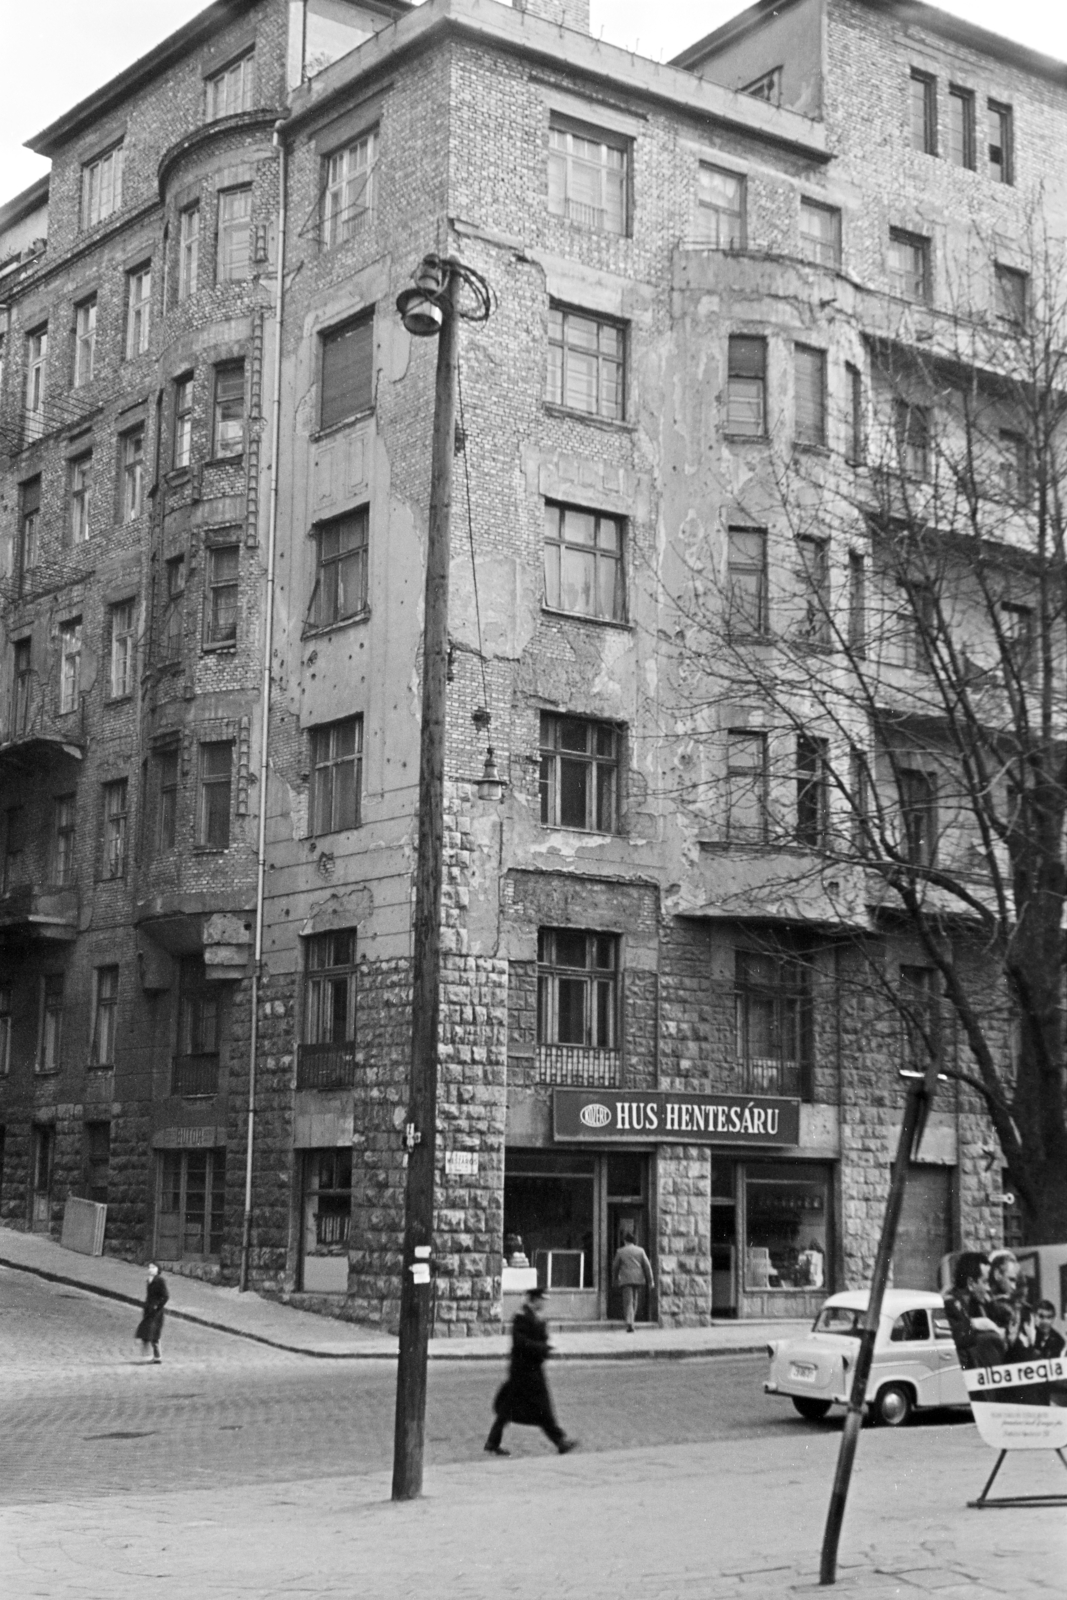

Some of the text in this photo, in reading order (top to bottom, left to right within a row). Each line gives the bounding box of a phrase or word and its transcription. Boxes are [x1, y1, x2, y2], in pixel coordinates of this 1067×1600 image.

[615, 1101, 780, 1135] HUS HENTESÁRU
[977, 1366, 1012, 1386] alba
